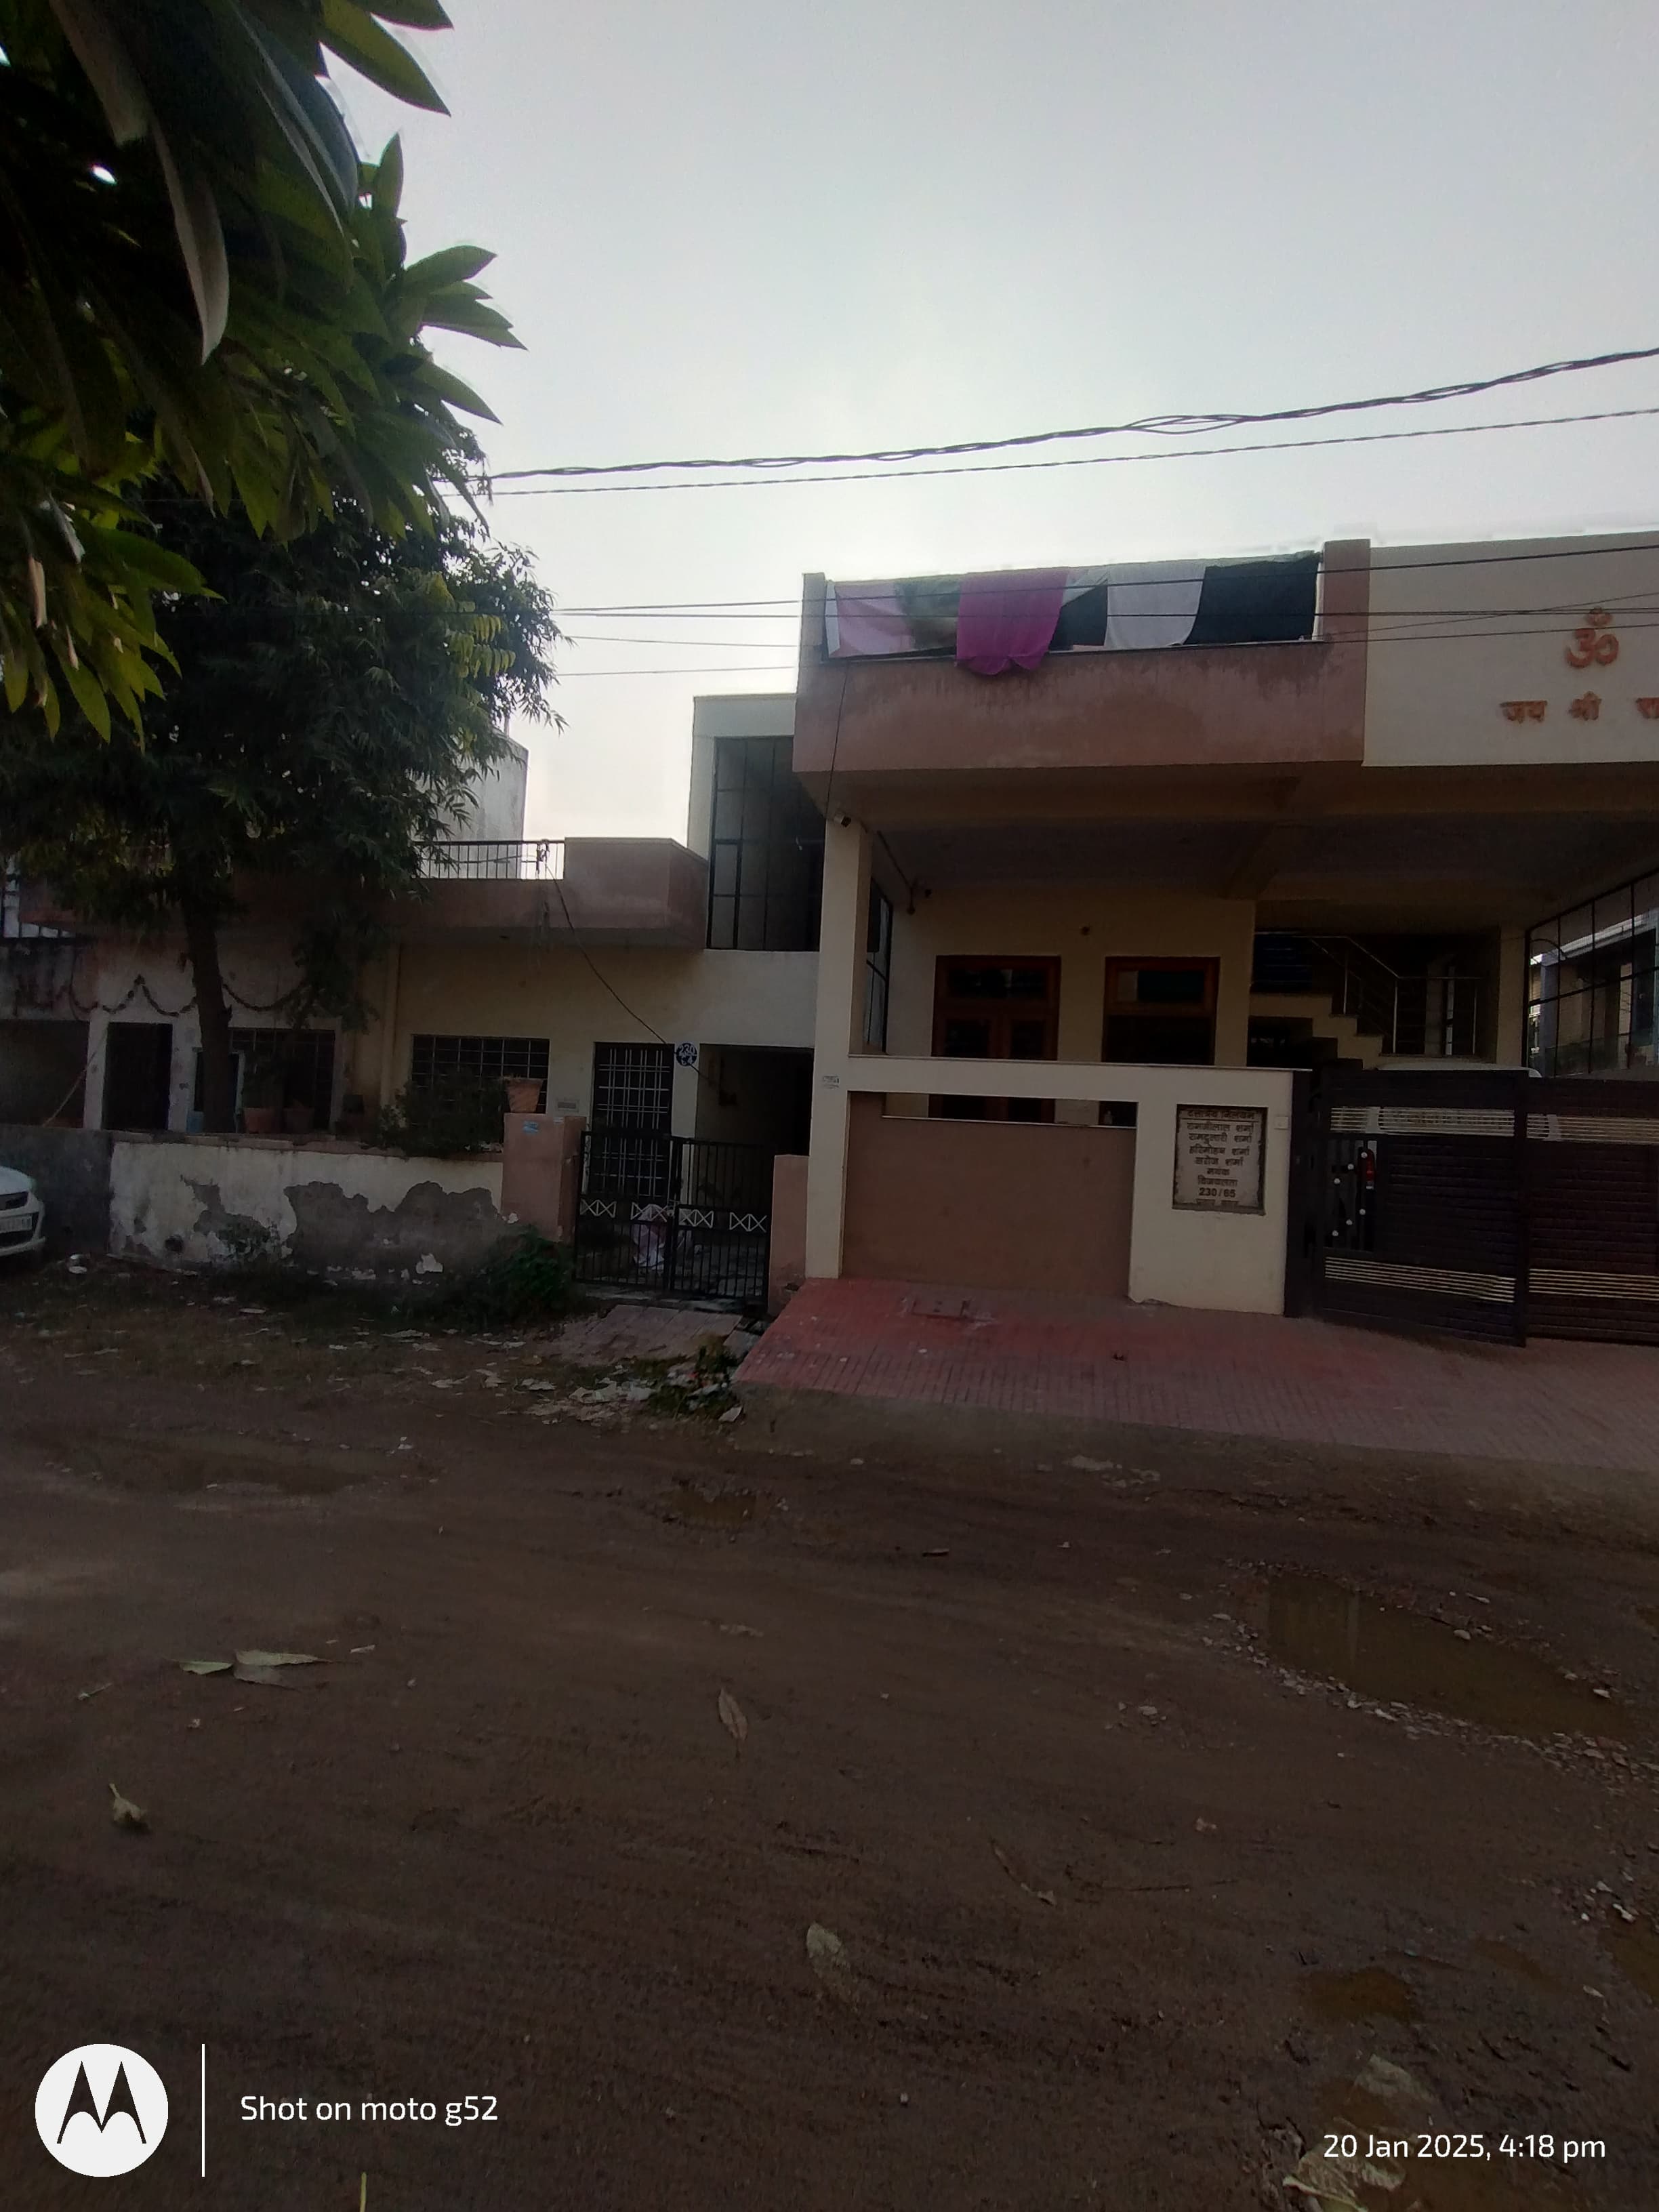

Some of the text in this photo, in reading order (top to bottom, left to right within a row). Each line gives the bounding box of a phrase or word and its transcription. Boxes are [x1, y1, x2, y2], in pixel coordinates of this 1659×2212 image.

[1236, 1123, 1254, 1132] शर्मा
[1234, 1133, 1252, 1143] शर्मा
[1231, 1146, 1250, 1155] शर्मा
[1225, 1156, 1244, 1166] शर्मा
